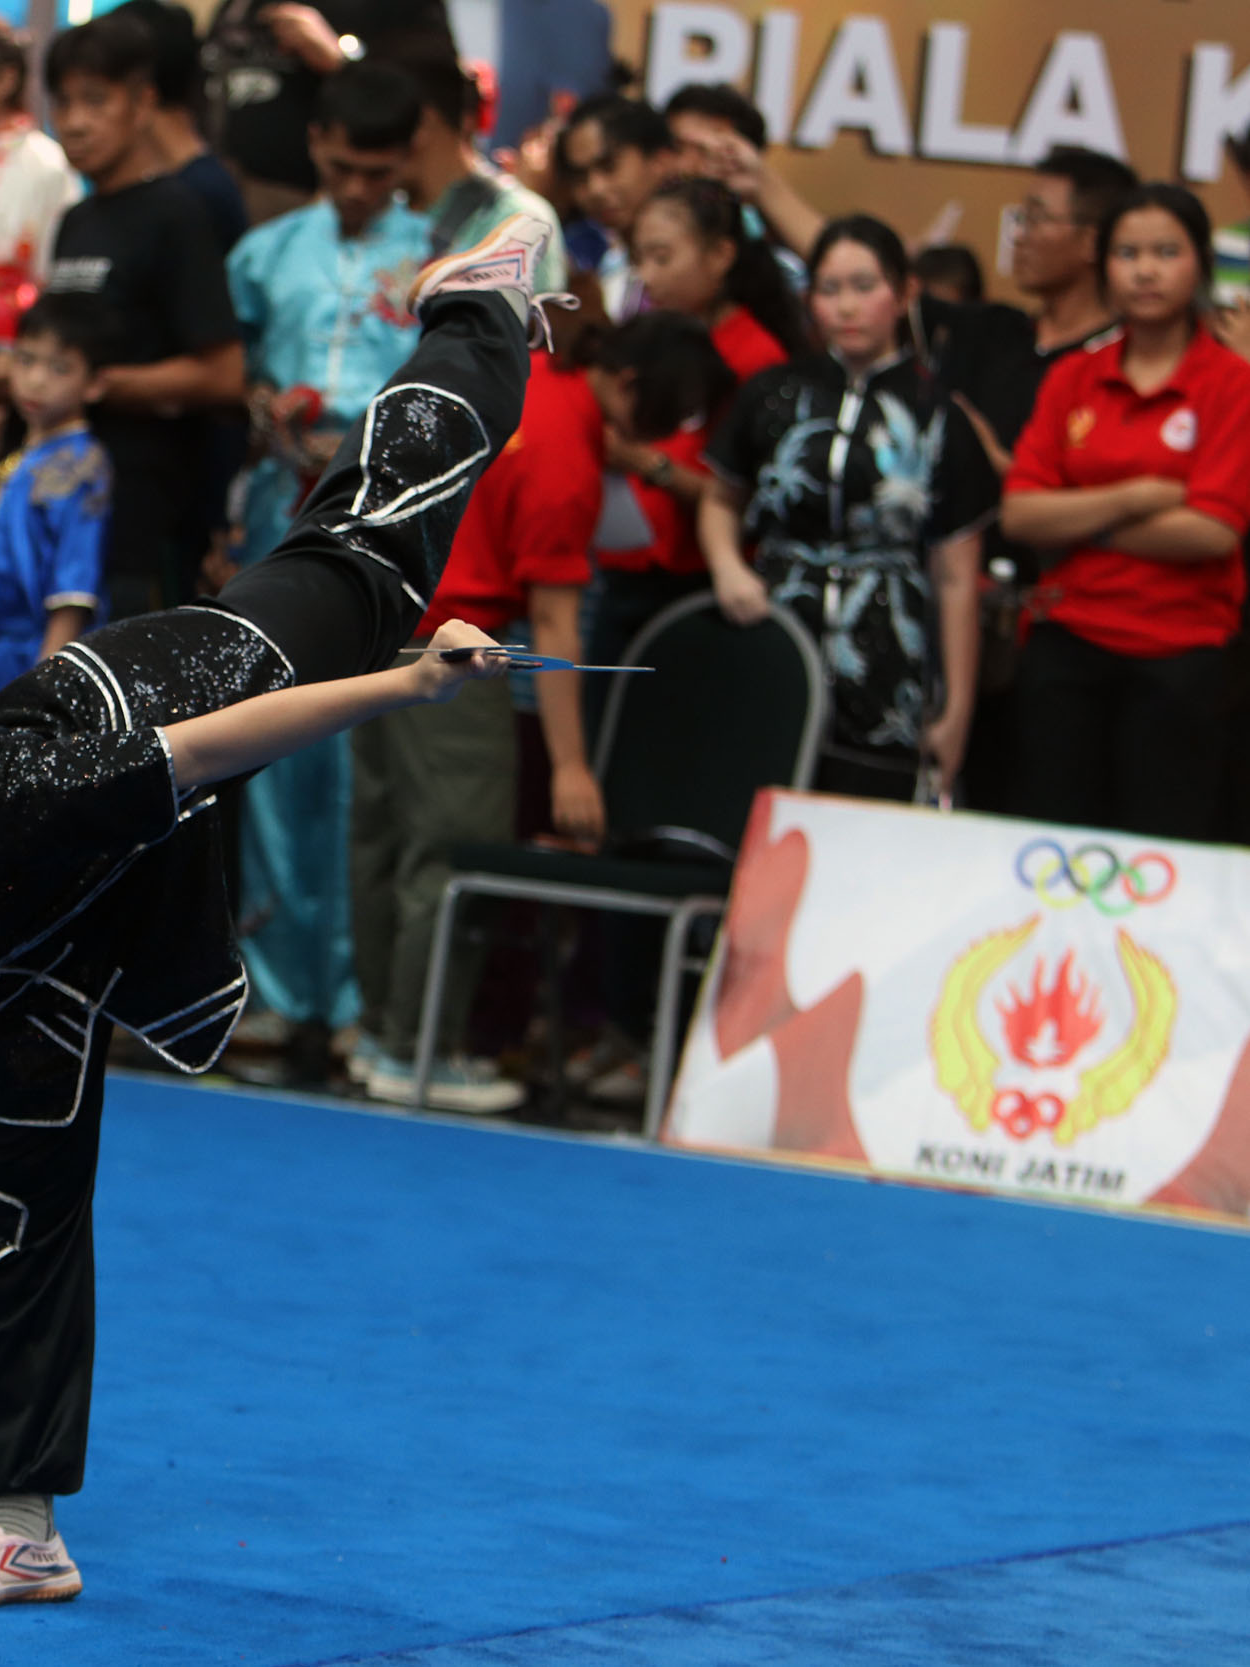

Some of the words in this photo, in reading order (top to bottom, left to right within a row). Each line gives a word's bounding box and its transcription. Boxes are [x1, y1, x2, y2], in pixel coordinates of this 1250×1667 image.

[645, 4, 1129, 168] PIALA
[916, 1142, 1007, 1179] KONI
[1016, 1156, 1127, 1193] JATIM
